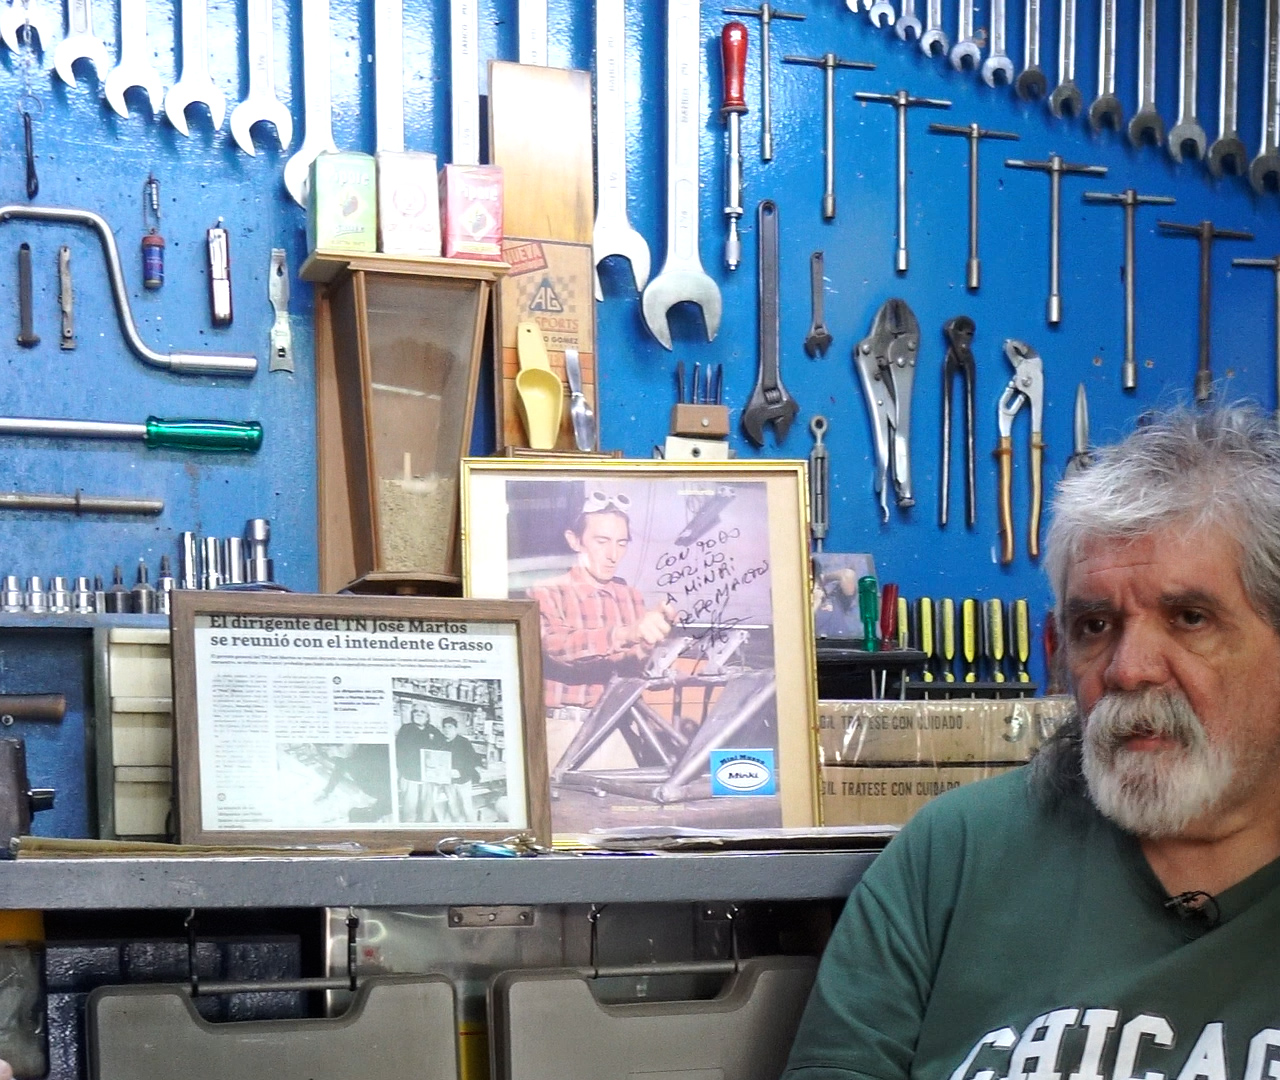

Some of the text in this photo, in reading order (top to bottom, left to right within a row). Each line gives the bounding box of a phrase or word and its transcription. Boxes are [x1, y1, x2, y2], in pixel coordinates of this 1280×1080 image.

[535, 316, 579, 330] SPORTS
[656, 548, 690, 570] CON
[666, 592, 677, 605] A
[209, 616, 468, 634] El dirigente del TN José Martos
[211, 633, 494, 652] se reunió con el intendente Grasso
[841, 715, 888, 729] TRATESE
[892, 715, 913, 729] CON
[918, 715, 963, 729] CUIDADO
[728, 772, 760, 780] Minki
[841, 781, 887, 796] TRATESE
[891, 781, 912, 796] CON
